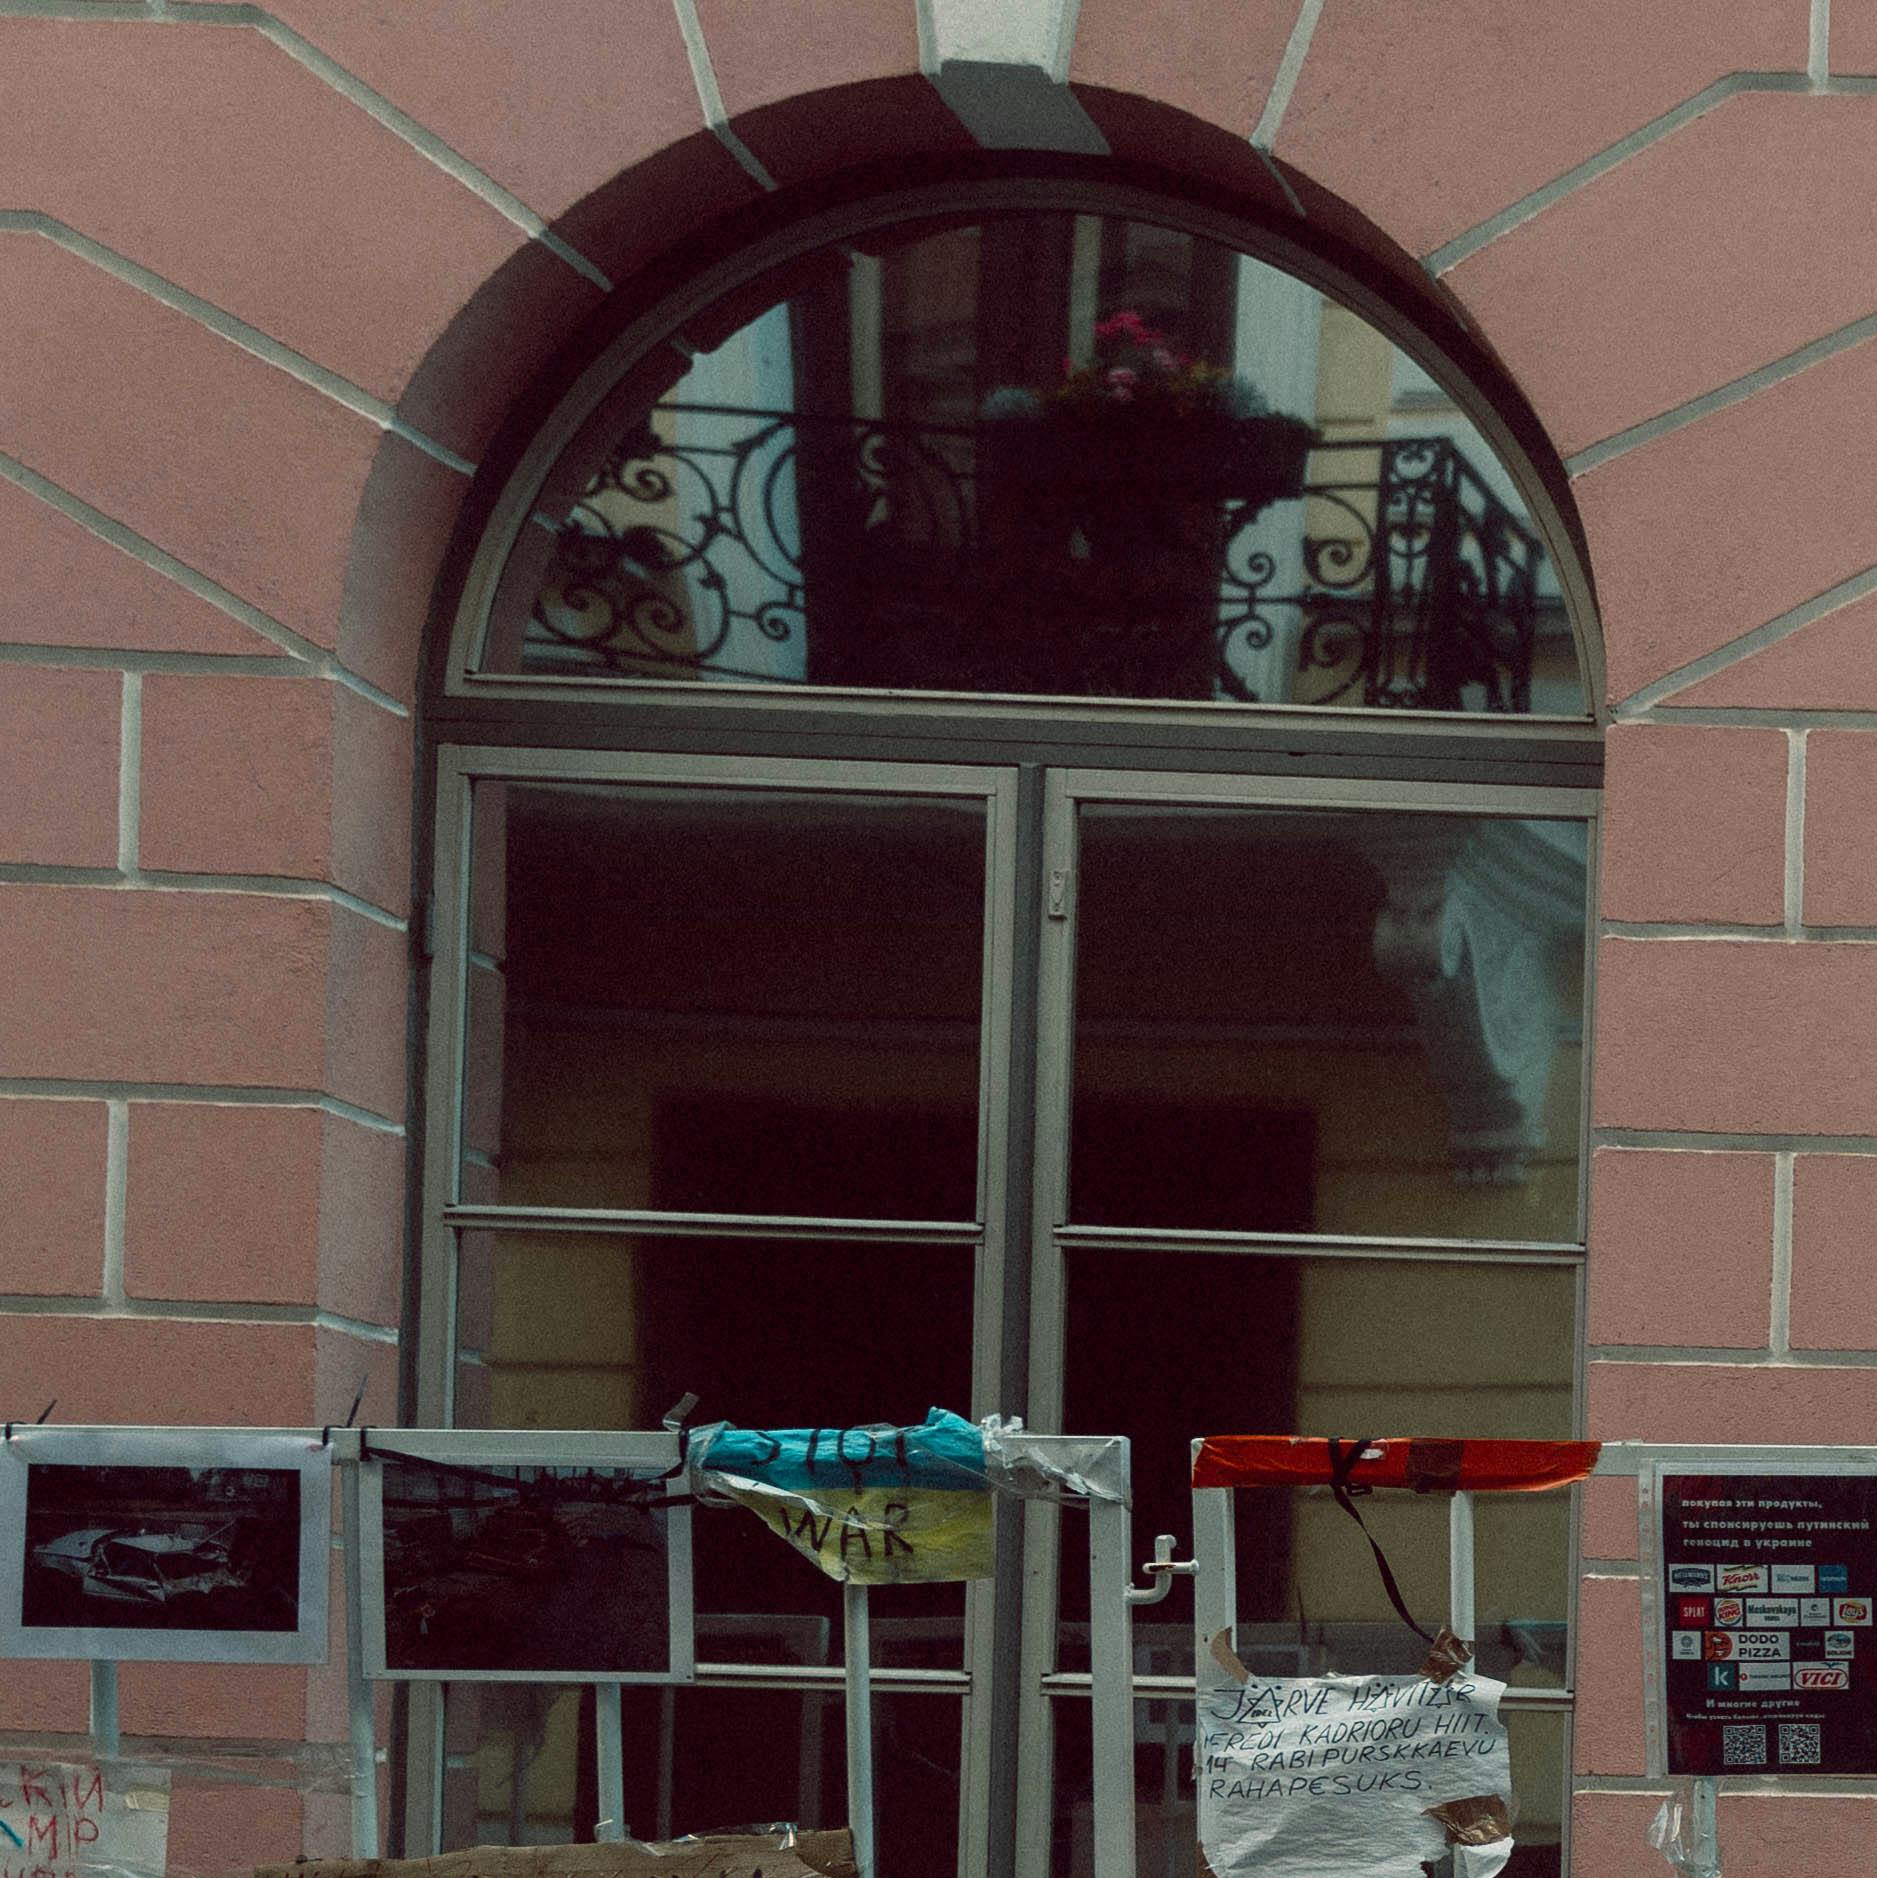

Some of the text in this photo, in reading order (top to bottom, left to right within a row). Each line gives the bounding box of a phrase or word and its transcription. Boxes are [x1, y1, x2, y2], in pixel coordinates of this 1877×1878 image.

[1704, 1520, 1793, 1530] спонсируешь
[781, 1503, 913, 1560] WAR
[1756, 1538, 1813, 1549] украине
[1722, 1572, 1760, 1584] Knorr
[1738, 1634, 1779, 1644] DODO
[1738, 1648, 1781, 1658] PIZZA
[1800, 1670, 1841, 1685] VICI
[1299, 1717, 1420, 1746] KADRIORU
[1251, 1740, 1496, 1771] RABI PURSKKAEVU
